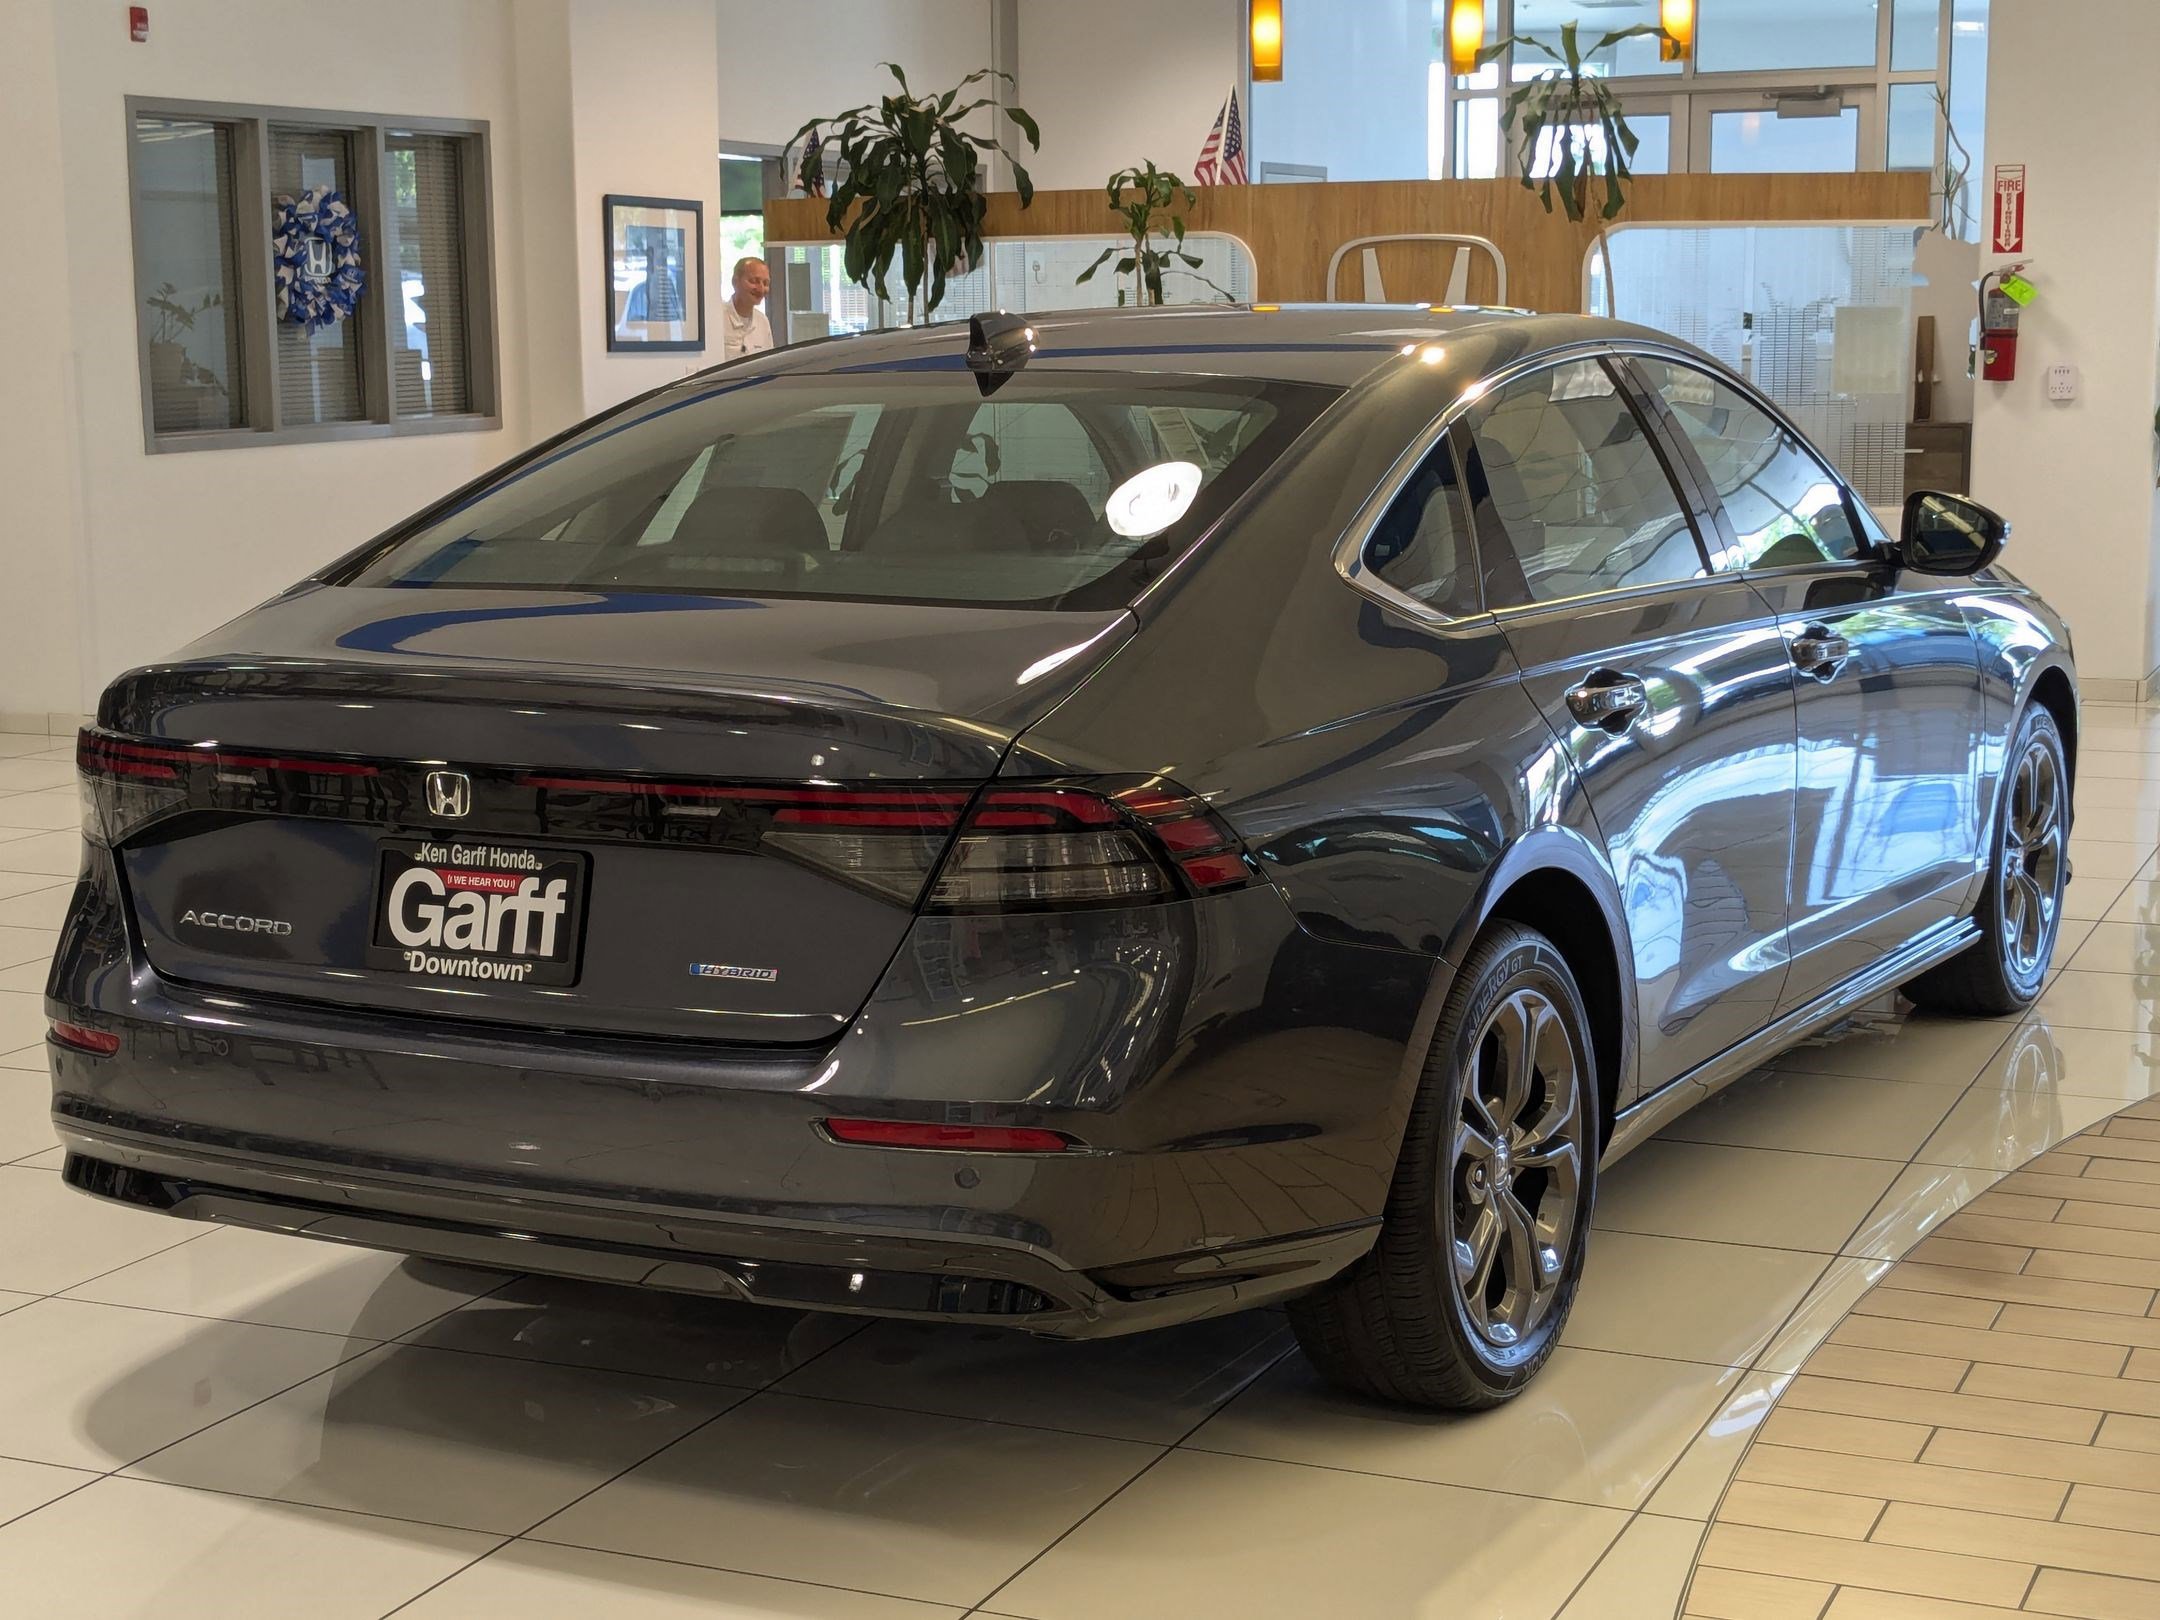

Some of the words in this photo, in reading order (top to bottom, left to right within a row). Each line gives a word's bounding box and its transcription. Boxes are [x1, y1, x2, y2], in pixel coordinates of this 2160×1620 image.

[1997, 180, 2021, 191] FIRE
[421, 842, 447, 863] Ken
[451, 844, 486, 867] Garff
[490, 848, 535, 870] Honda
[453, 875, 467, 885] WE
[468, 876, 491, 887] HEAR
[492, 878, 510, 889] YOU
[179, 910, 292, 936] ACCORD
[388, 867, 567, 957] Garff
[409, 950, 524, 982] Downtown
[701, 965, 773, 979] HYBRID
[1511, 954, 1523, 973] GT
